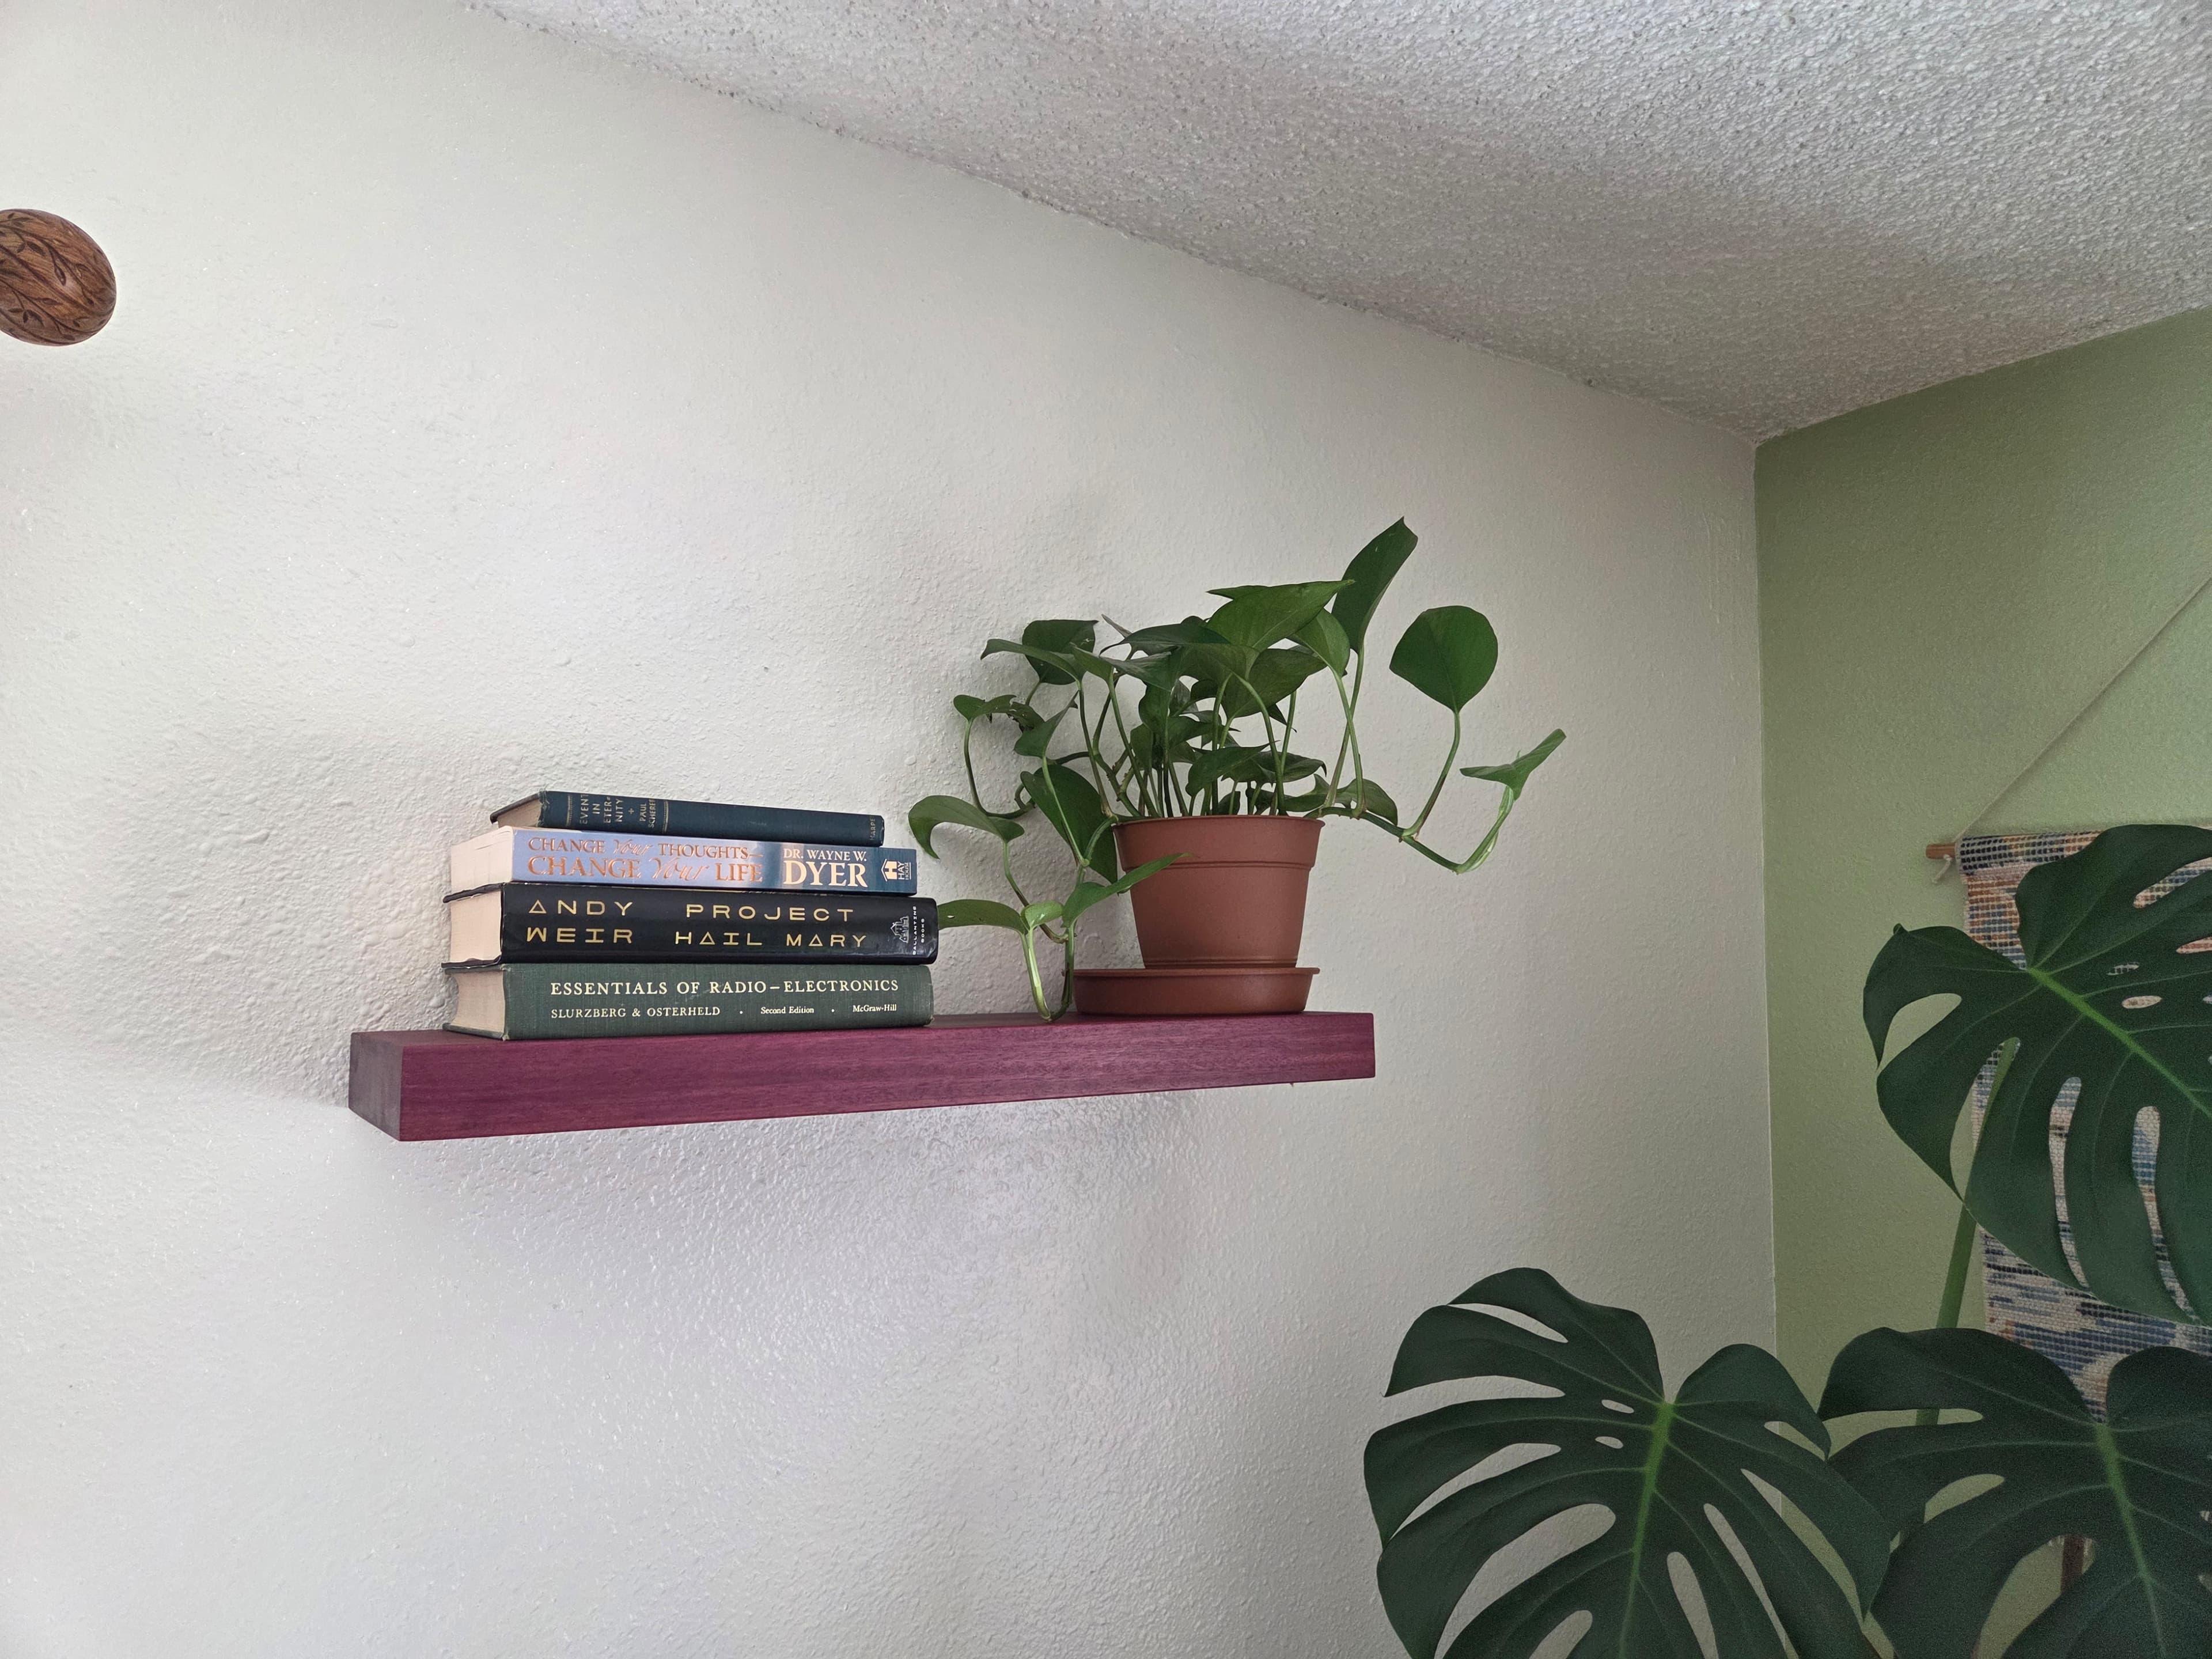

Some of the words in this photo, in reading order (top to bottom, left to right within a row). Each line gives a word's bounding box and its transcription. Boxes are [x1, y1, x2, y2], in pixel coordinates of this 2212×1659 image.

[592, 803, 600, 814] IN
[615, 798, 623, 822] NITY
[528, 837, 605, 853] CHANGE
[613, 839, 653, 855] Your
[783, 849, 804, 858] DR.
[807, 850, 850, 861] WAYNE
[853, 851, 867, 862] W.
[528, 855, 641, 878] CHANGE
[649, 857, 710, 881] Your
[715, 863, 763, 882] LIFE
[783, 860, 868, 888] DYER
[528, 899, 633, 916] ANDY
[686, 904, 853, 922] PROJECT
[527, 927, 633, 944] WEIR
[675, 931, 763, 945] HAIL
[786, 933, 866, 948] MARY
[551, 982, 668, 995] ESSENTIALS
[677, 982, 700, 994] OF
[551, 1008, 626, 1018] SLURZBERG
[632, 1008, 641, 1017] &
[647, 1006, 720, 1017] OSTERHELD
[760, 1006, 786, 1014] Second
[853, 1004, 897, 1013] McGraw-Hill
